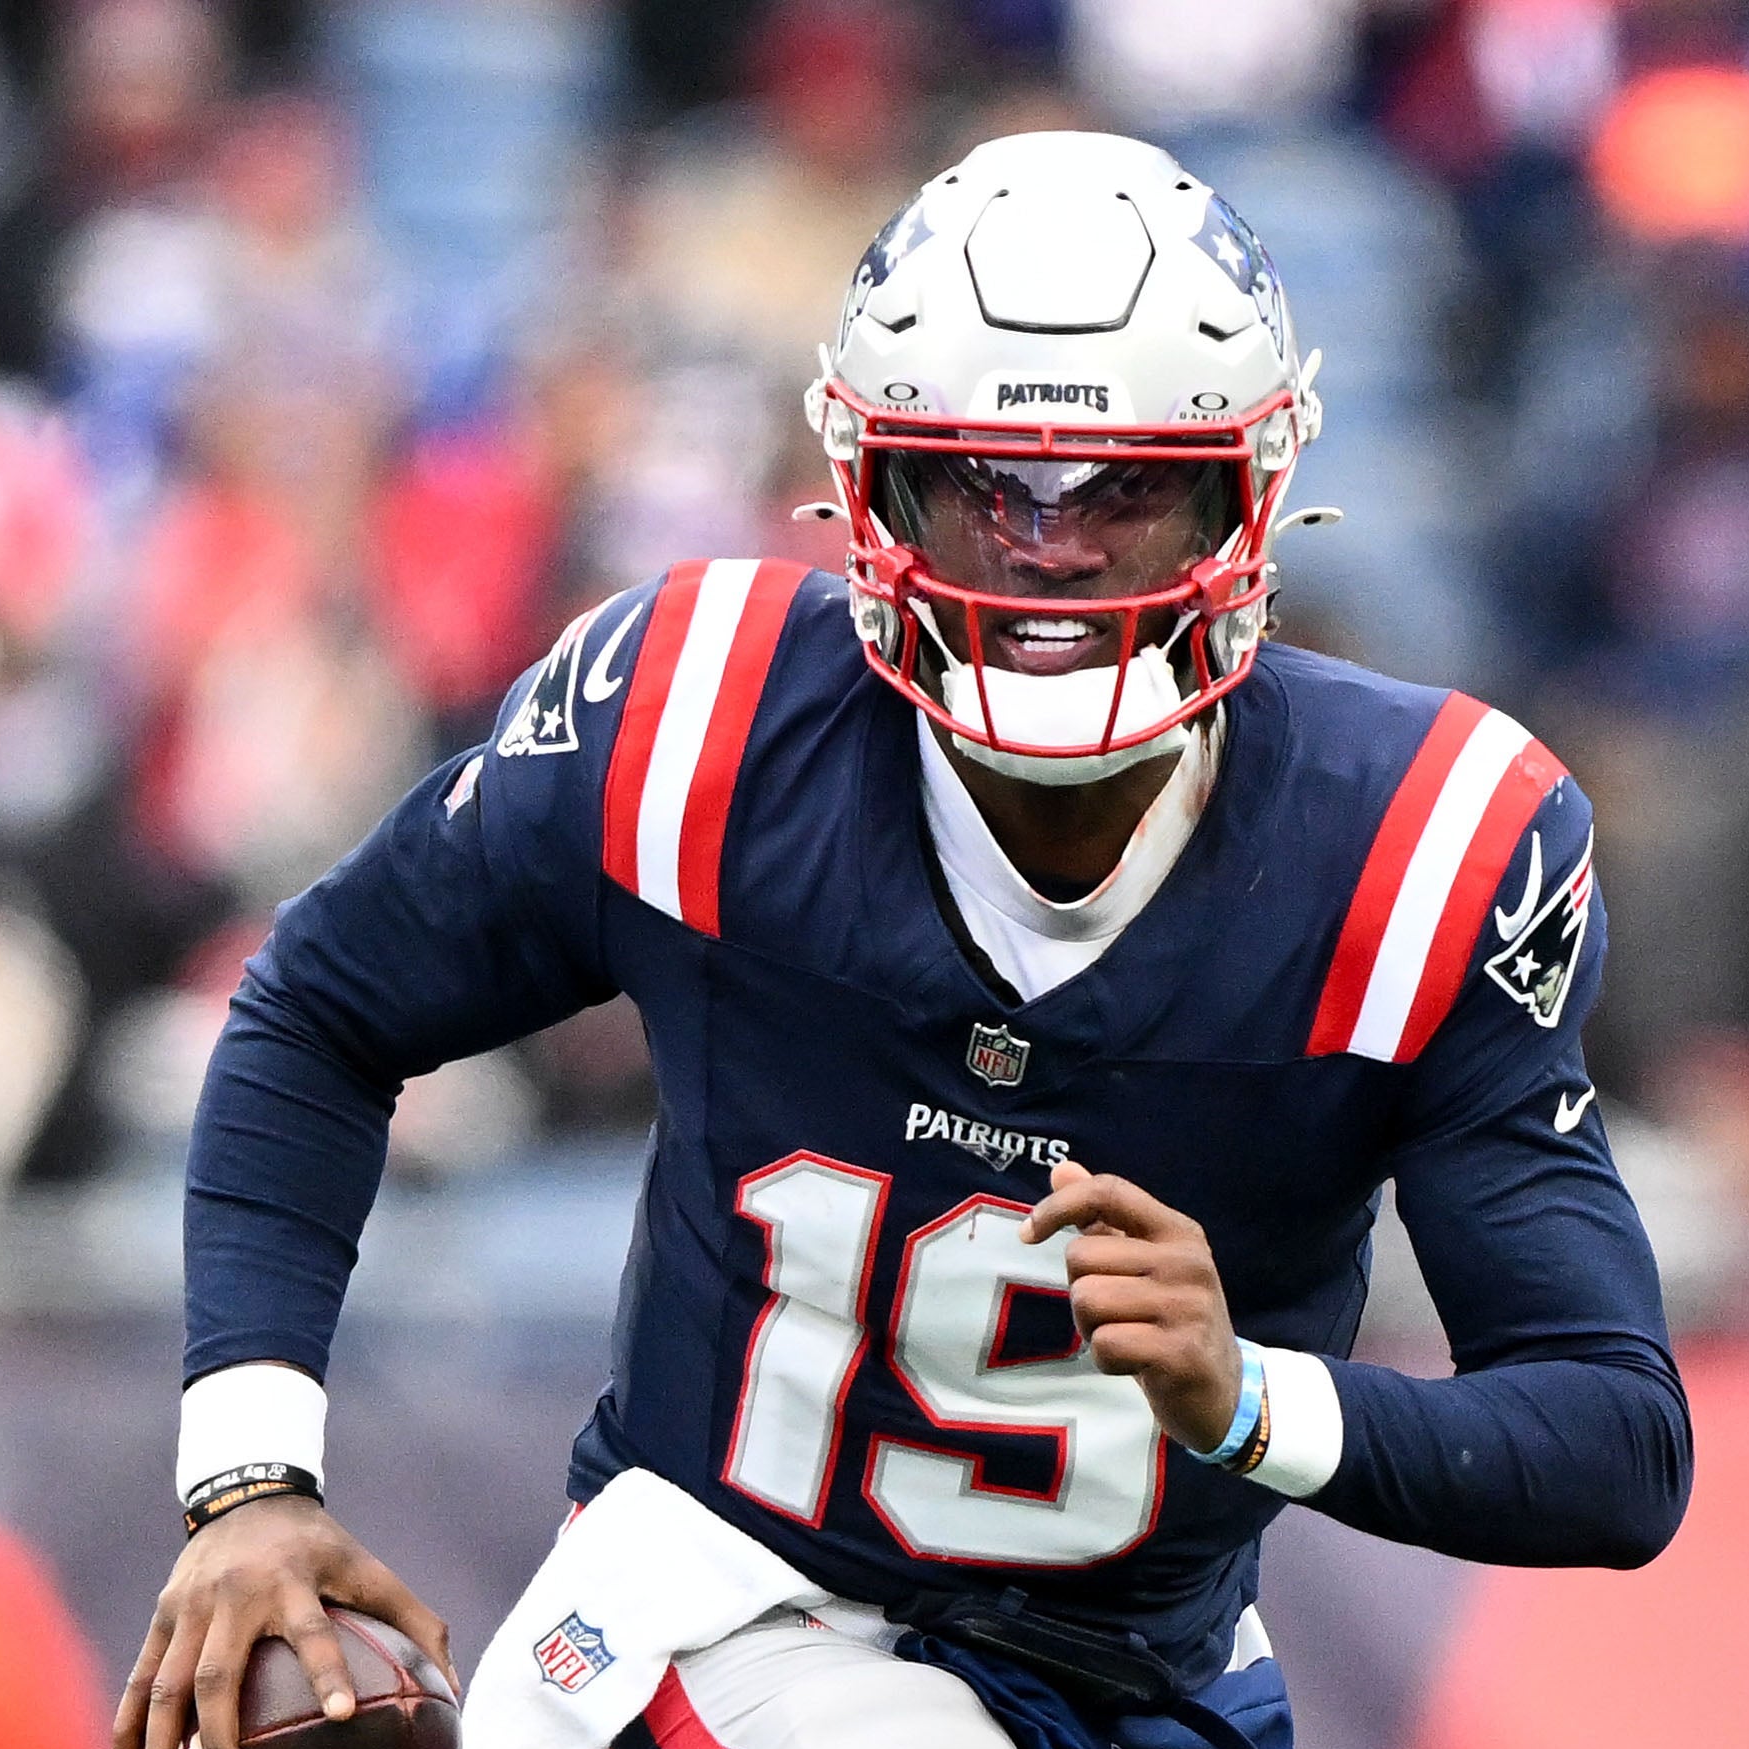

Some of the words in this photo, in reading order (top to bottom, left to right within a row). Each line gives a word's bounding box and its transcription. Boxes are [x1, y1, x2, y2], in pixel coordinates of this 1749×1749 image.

[996, 383, 1109, 412] PATRIOTS
[973, 1049, 1016, 1079] NFL
[905, 1103, 1070, 1168] PATRIOTS
[720, 1148, 1167, 1569] 19
[538, 1634, 588, 1689] NFL
